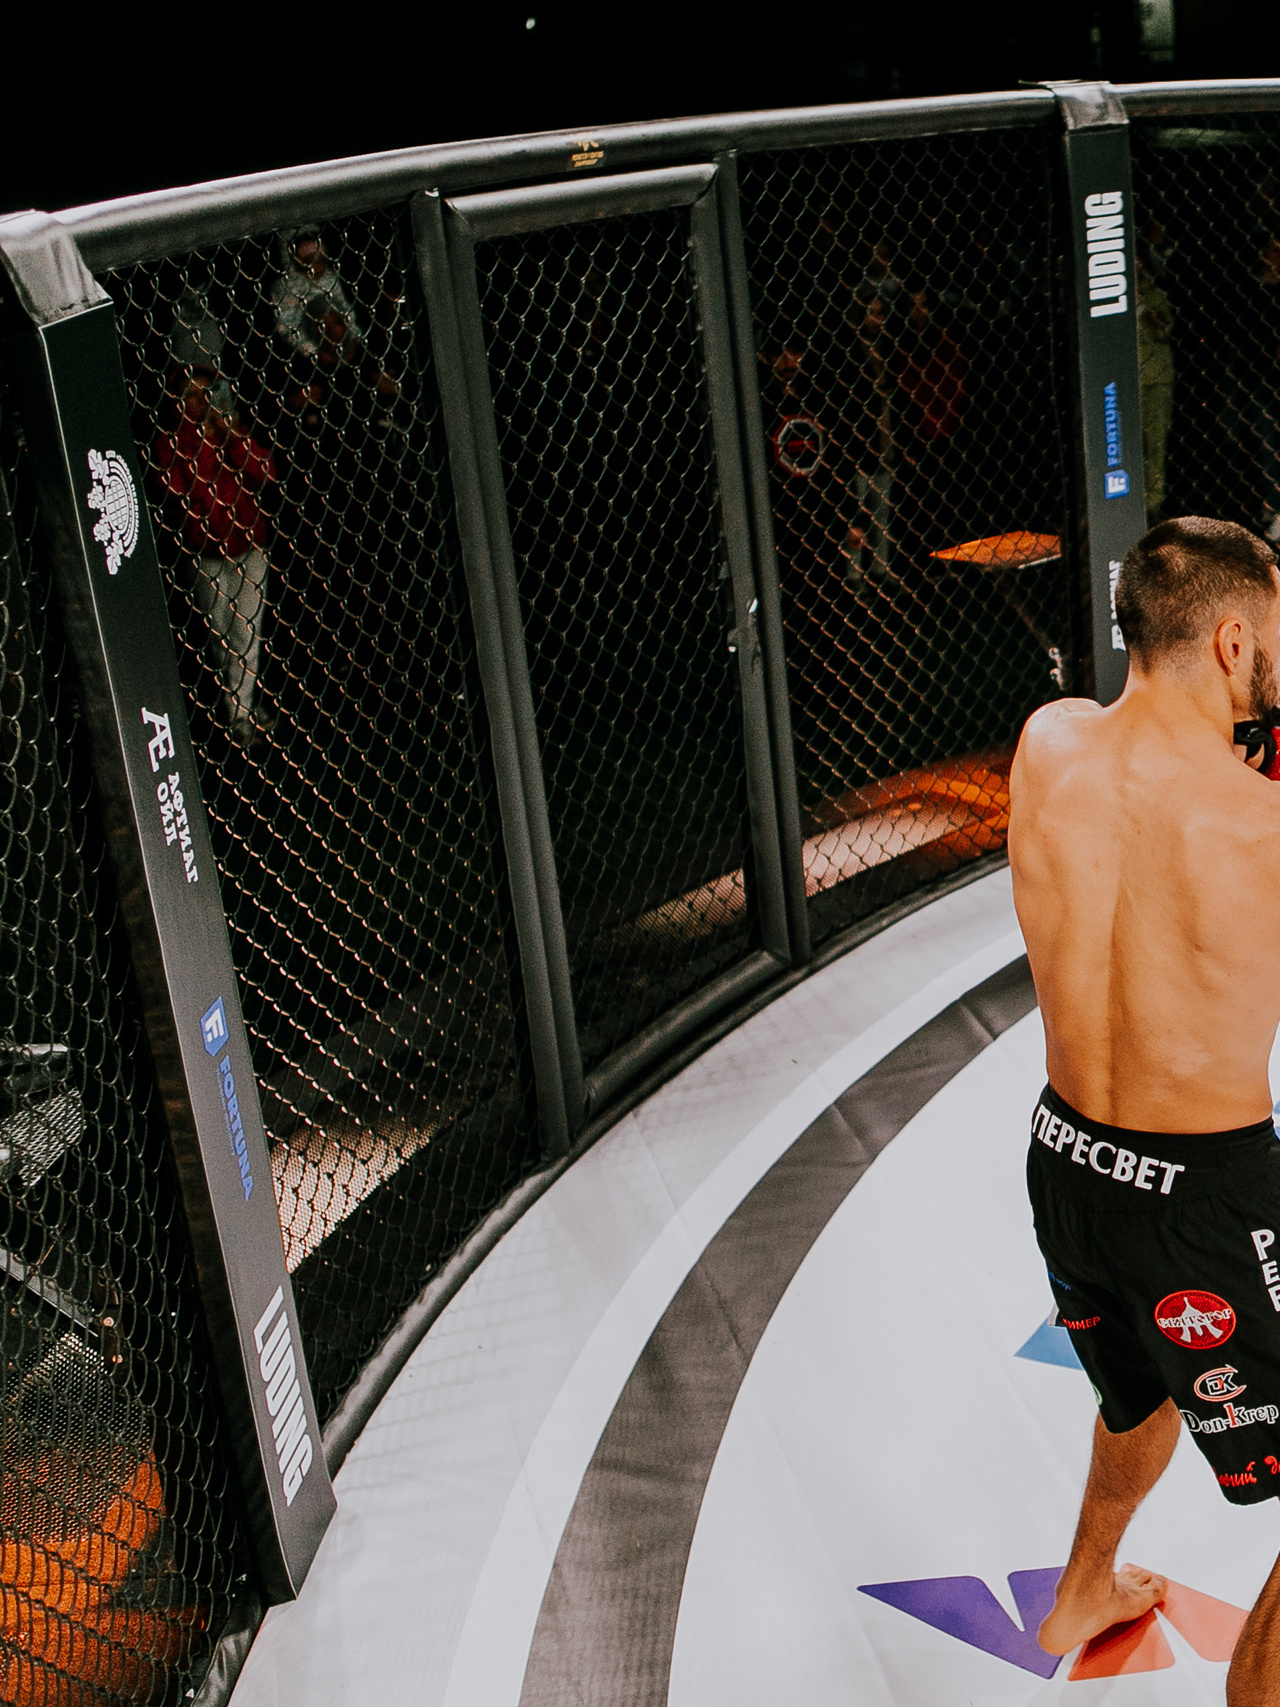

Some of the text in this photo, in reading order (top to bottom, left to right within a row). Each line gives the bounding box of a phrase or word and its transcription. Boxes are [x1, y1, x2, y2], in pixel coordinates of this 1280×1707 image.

[1084, 190, 1128, 318] LUDING
[1104, 381, 1119, 467] FORTUNA
[219, 1054, 254, 1201] FORTUNA
[1031, 1103, 1186, 1196] ПЕРЕСВЕТ
[253, 1285, 313, 1507] LUDING
[1179, 1402, 1280, 1434] Don-Krep
